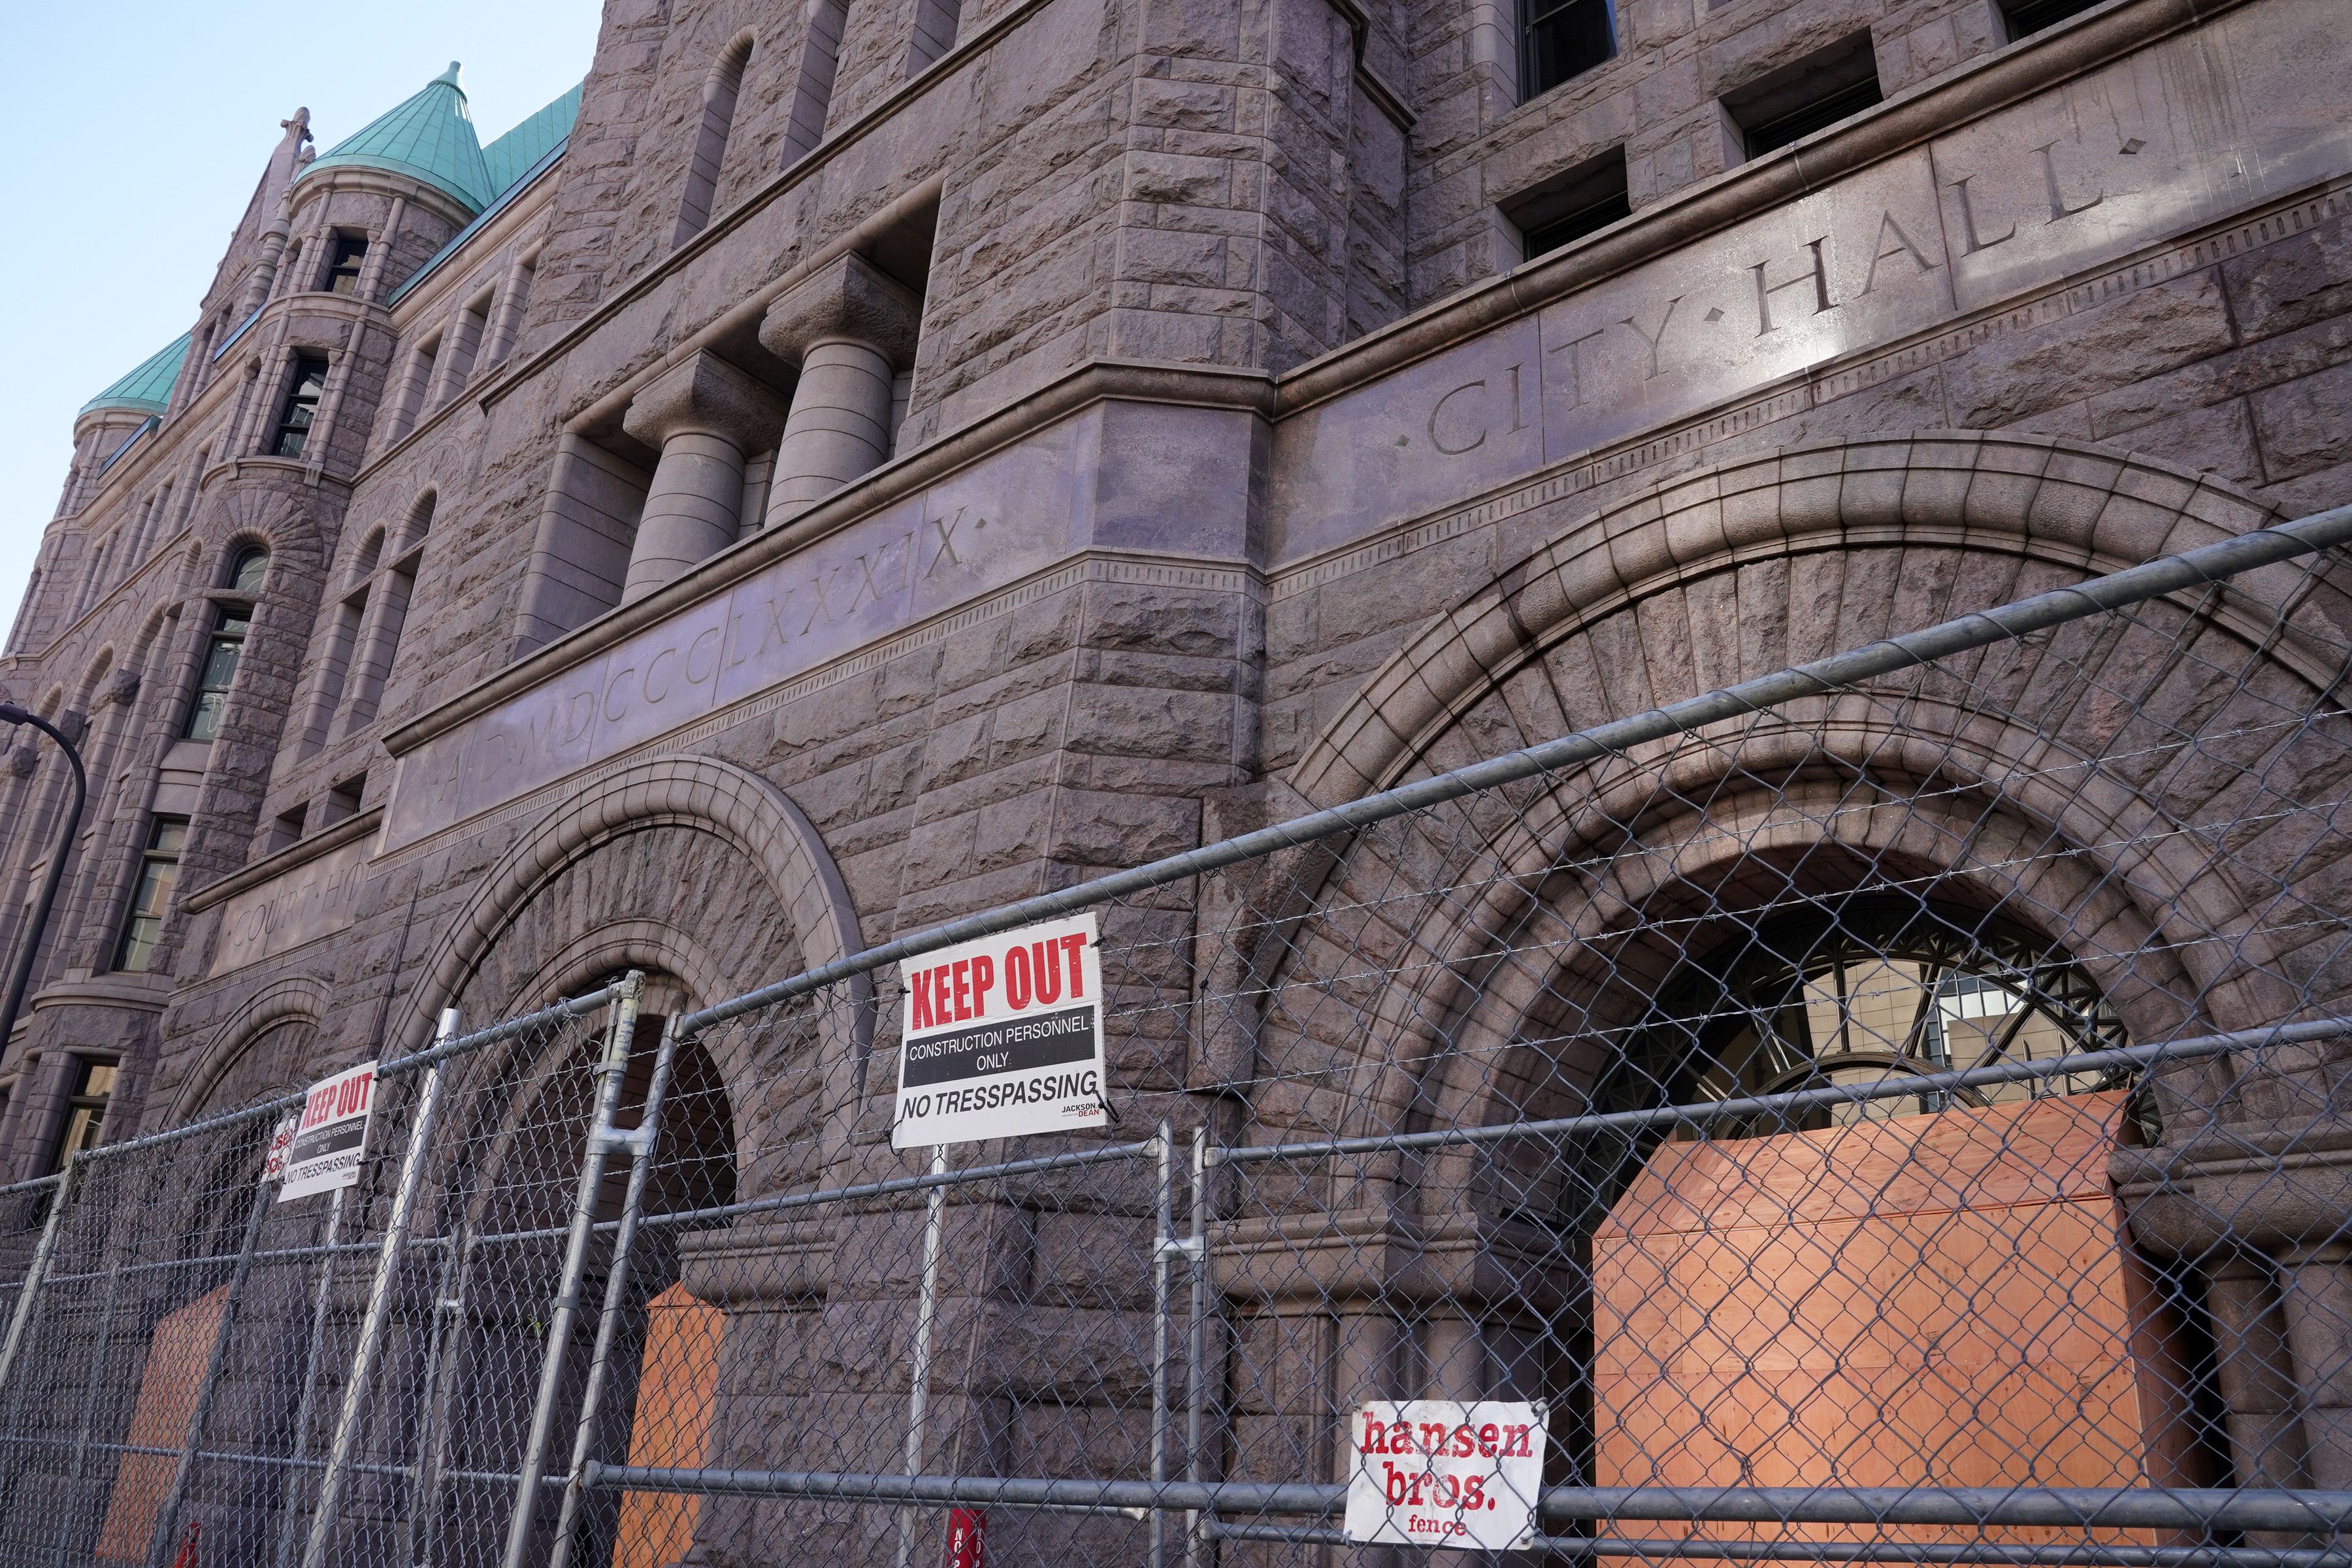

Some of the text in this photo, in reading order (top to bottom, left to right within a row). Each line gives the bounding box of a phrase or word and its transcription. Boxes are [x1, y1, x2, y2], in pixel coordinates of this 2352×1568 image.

[233, 881, 316, 947] COURT
[911, 932, 1087, 1031] KEEP OUT
[909, 1015, 1090, 1062] CONSTRUCTION PERSONNEL
[976, 1051, 1009, 1071] ONLY
[301, 1071, 373, 1131] KEEP OUT
[902, 1070, 1098, 1120] NO TRESSPASSING
[1062, 1102, 1096, 1113] JACKSON
[1078, 1109, 1100, 1117] DEAN
[295, 1129, 332, 1149] CONSTRUCTION
[331, 1120, 363, 1137] PERSONNEL
[316, 1141, 332, 1154] ONLY
[286, 1169, 298, 1184] NO
[297, 1152, 361, 1182] TRESSPASSING
[1360, 1411, 1533, 1458] hansen
[1382, 1461, 1495, 1511] bros.
[1408, 1514, 1468, 1537] fence
